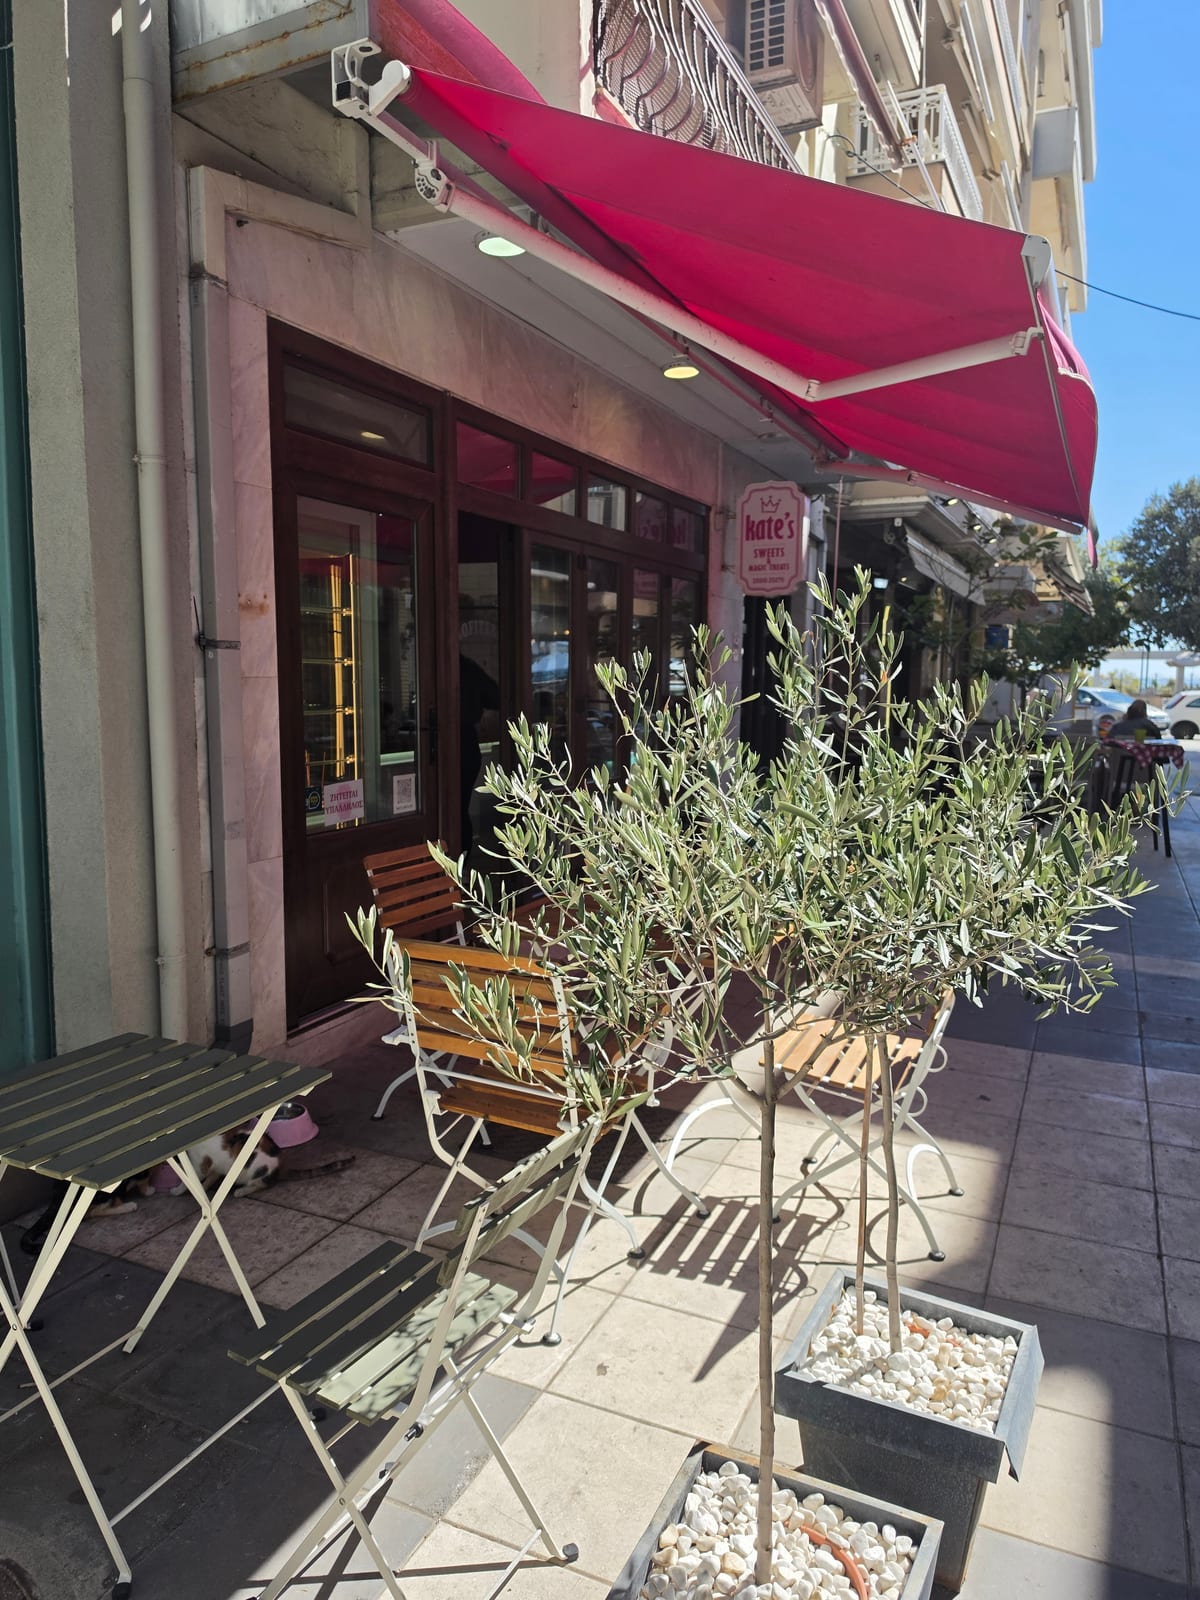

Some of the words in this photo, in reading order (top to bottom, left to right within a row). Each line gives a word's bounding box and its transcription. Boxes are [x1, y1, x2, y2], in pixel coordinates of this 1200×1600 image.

[745, 512, 794, 541] kate's
[753, 547, 785, 558] SWEETS
[330, 790, 358, 802] ΖΗΤΕΙΤΑΙ
